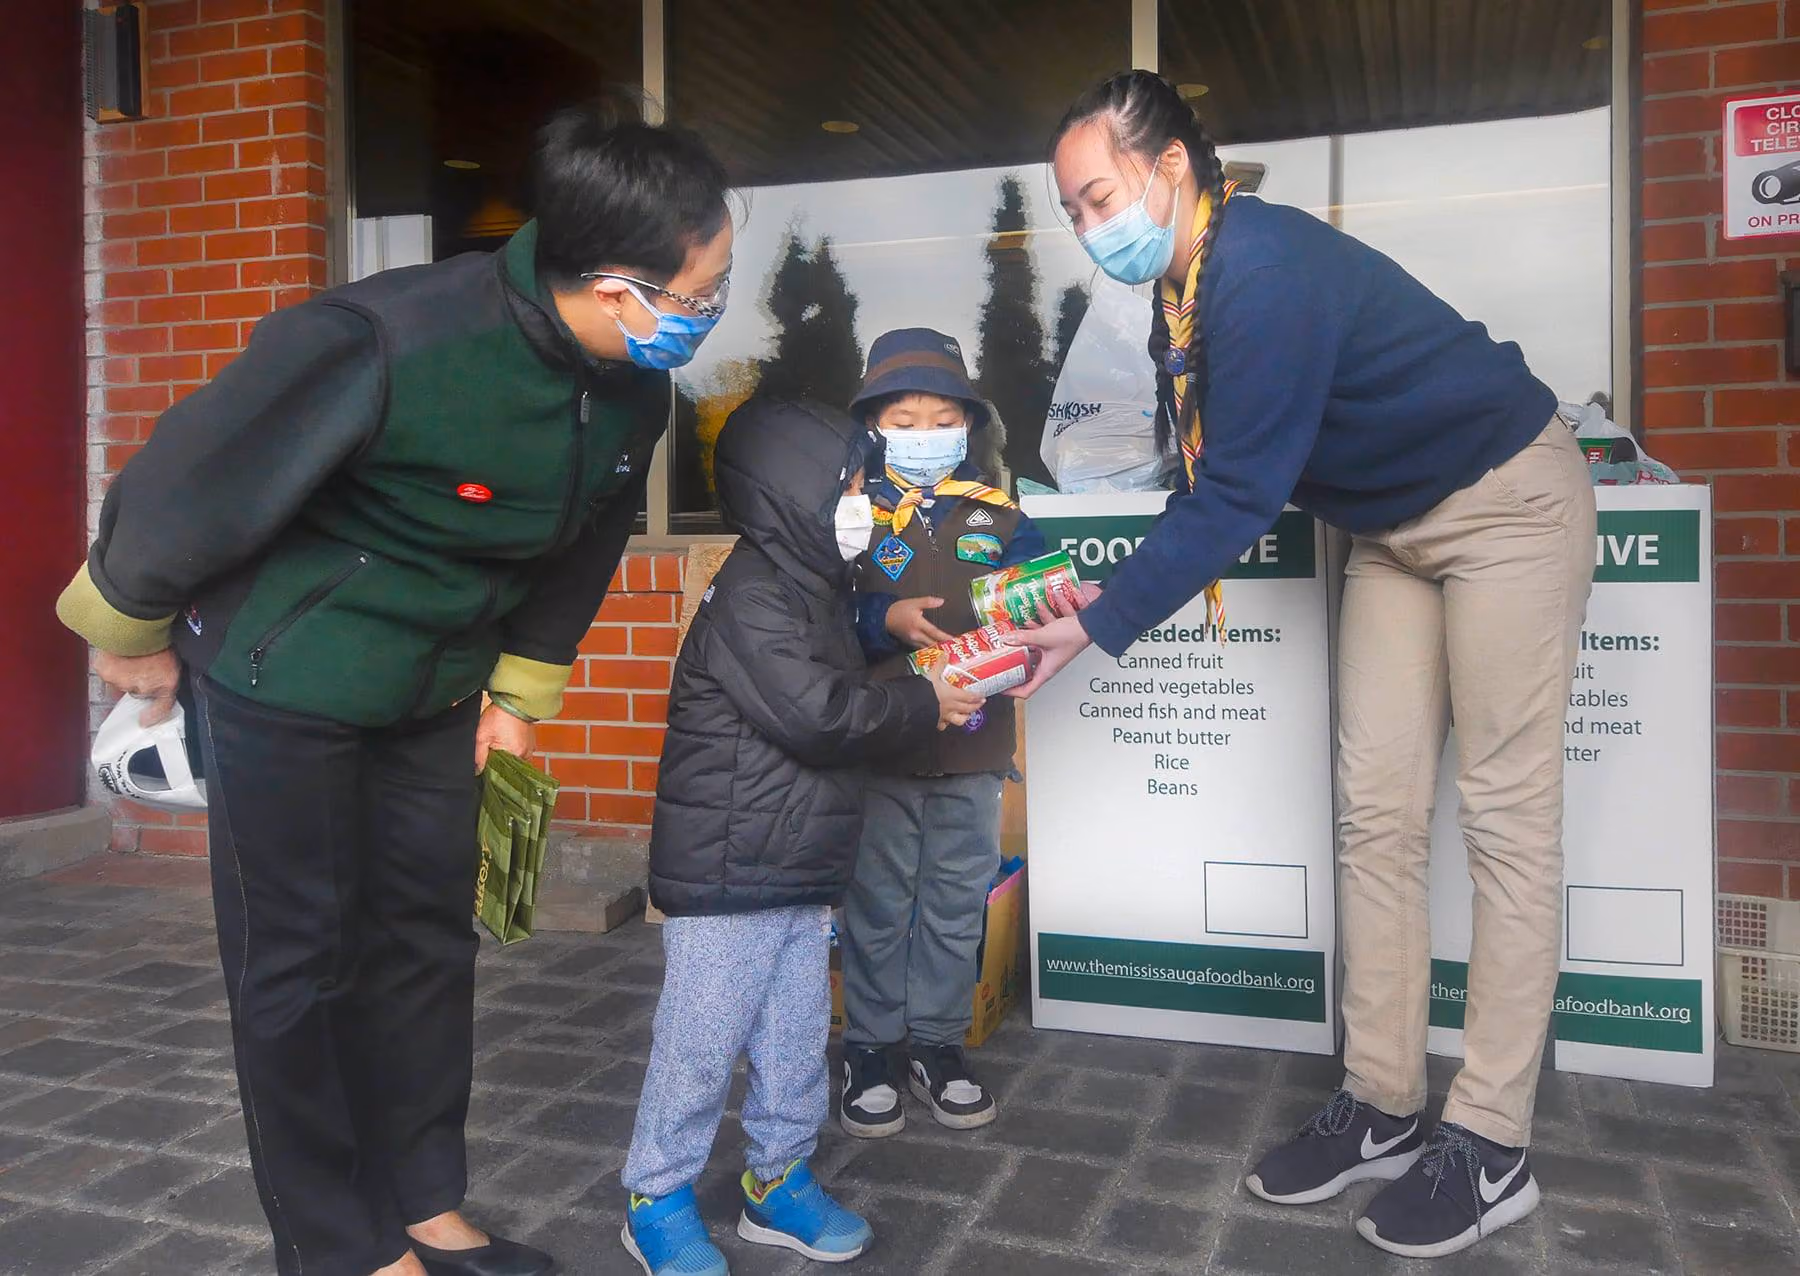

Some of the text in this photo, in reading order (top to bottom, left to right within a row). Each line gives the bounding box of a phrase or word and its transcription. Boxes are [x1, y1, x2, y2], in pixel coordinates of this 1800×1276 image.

[1766, 105, 1800, 120] CLO
[1767, 121, 1800, 136] CIR
[1751, 136, 1800, 152] TELE
[1748, 213, 1800, 228] ON PR
[1060, 537, 1146, 566] FOO
[1596, 535, 1659, 565] IVE
[1138, 624, 1281, 642] eeded Iems:
[1581, 631, 1659, 651] Items:
[1117, 653, 1224, 669] Canned fruit
[1089, 677, 1255, 698] Canned vegetables
[1569, 689, 1628, 707] tables
[1079, 702, 1267, 721] Canned fish and meat
[1591, 719, 1642, 735] meat
[1112, 728, 1231, 746] Peanut butter
[1154, 754, 1190, 770] Rice
[1564, 746, 1601, 761] tter
[1147, 779, 1199, 796] Beans
[1047, 958, 1315, 993] www.themississaugafoodbank.org
[1551, 996, 1692, 1023] afoodbank.org
